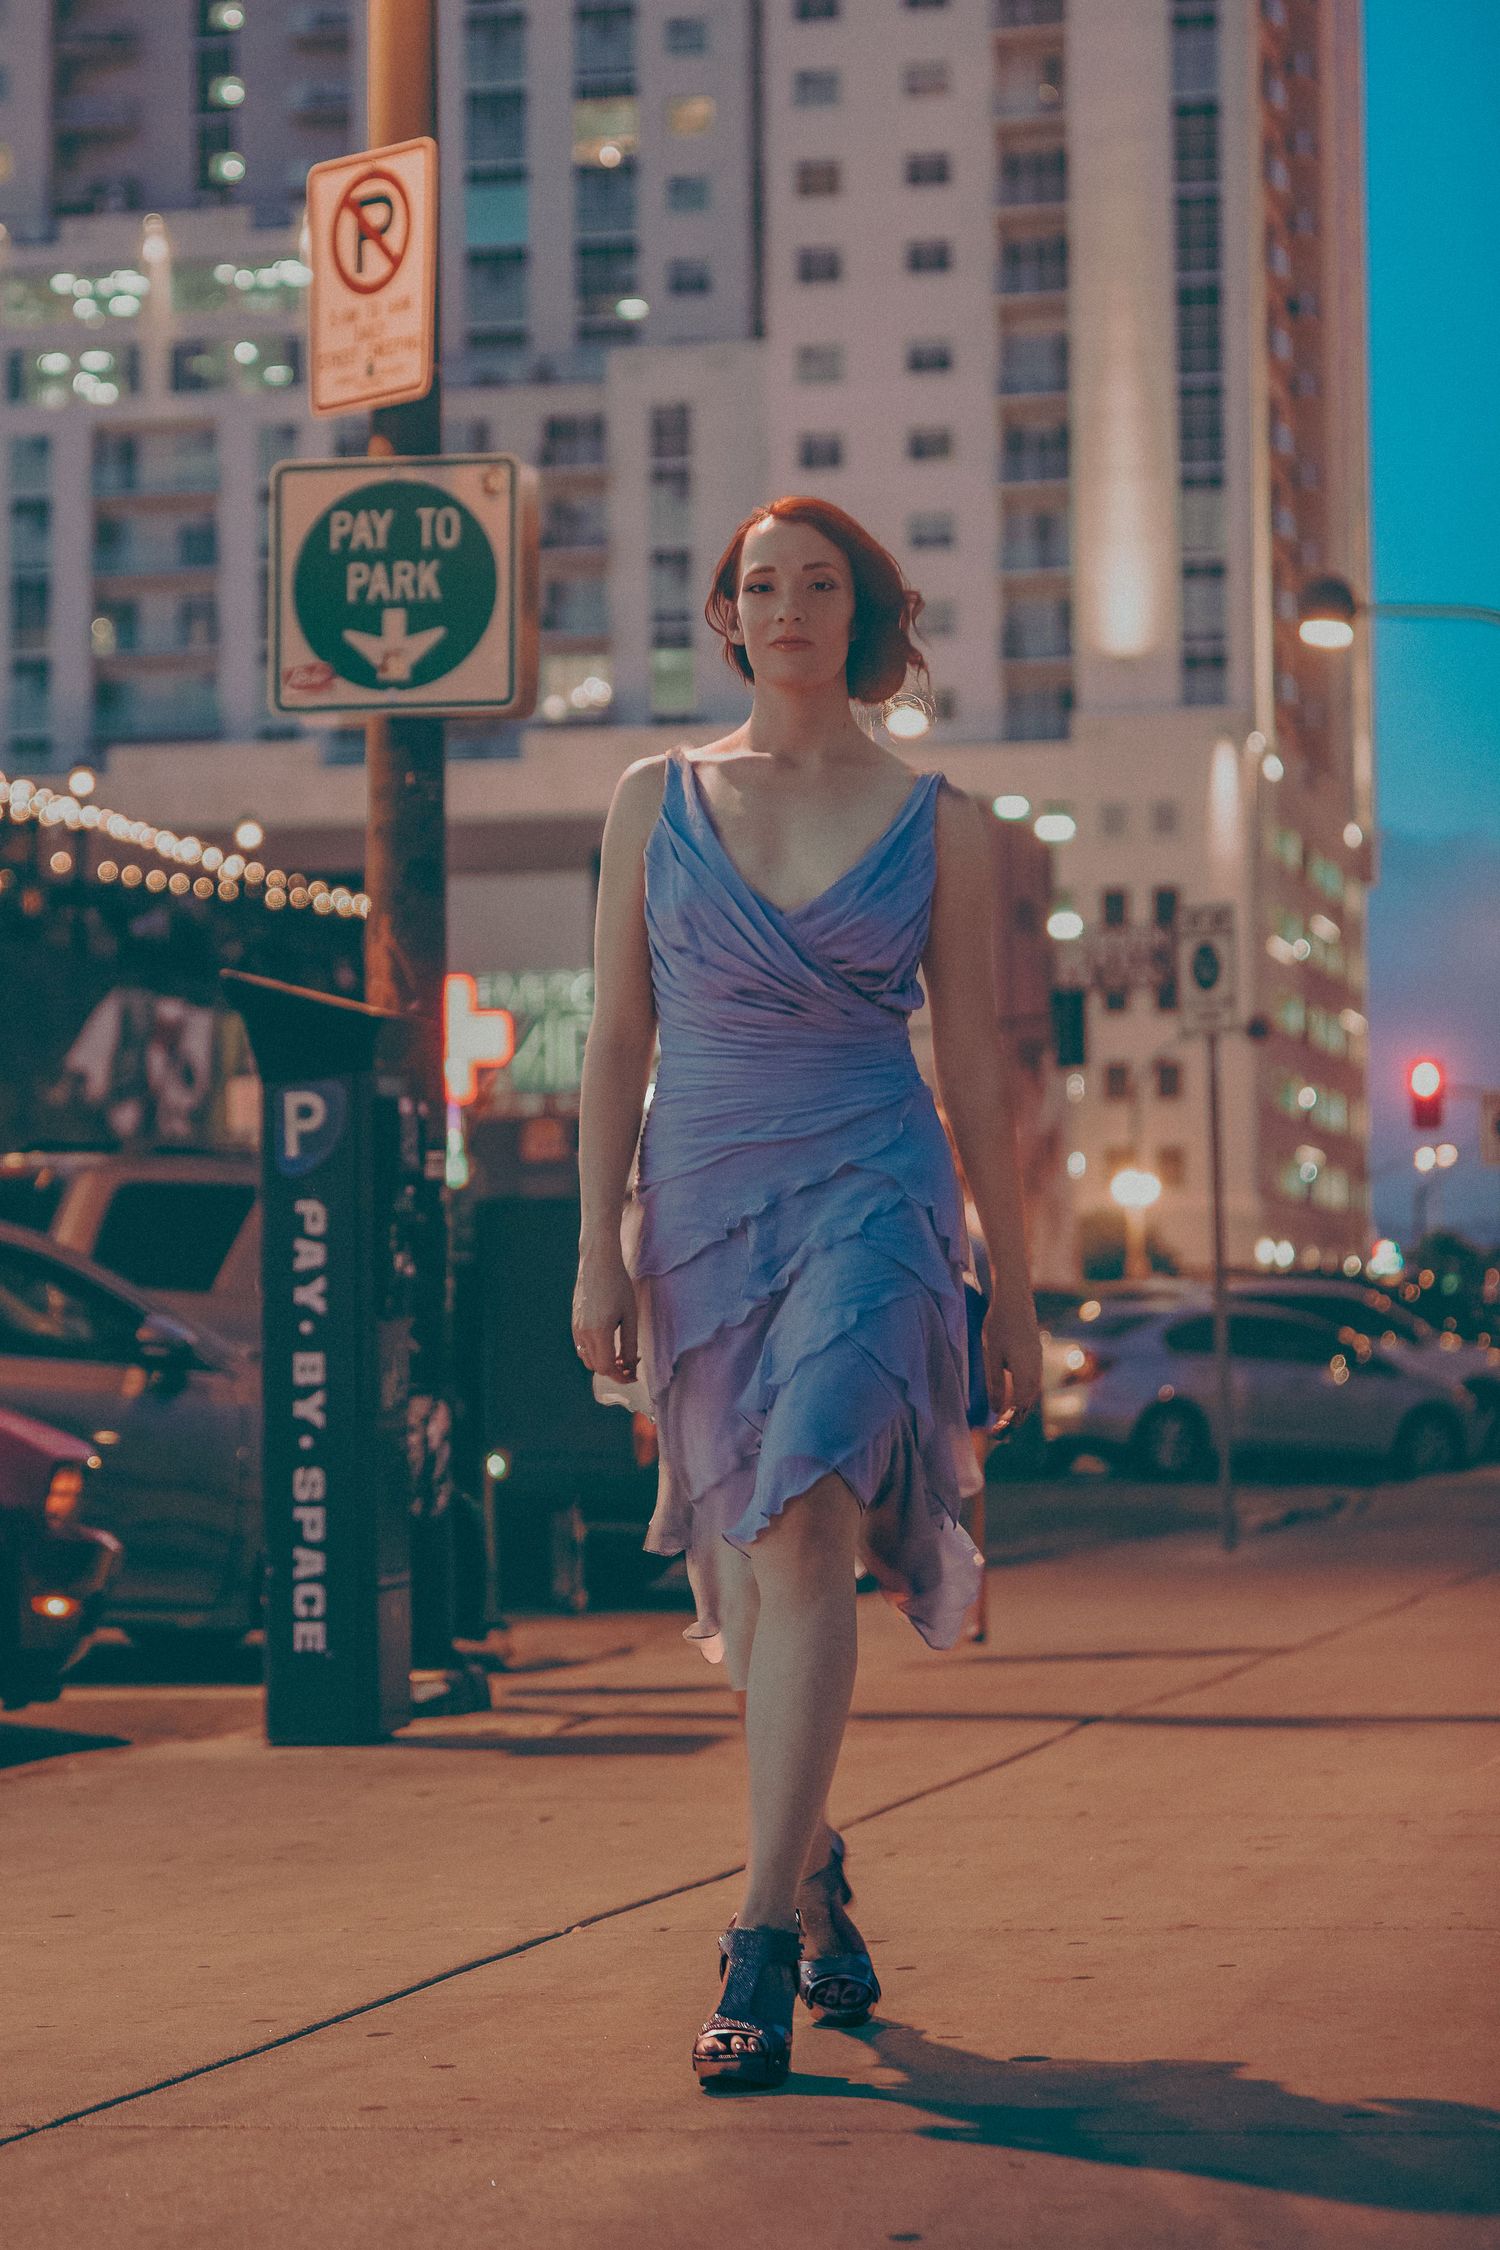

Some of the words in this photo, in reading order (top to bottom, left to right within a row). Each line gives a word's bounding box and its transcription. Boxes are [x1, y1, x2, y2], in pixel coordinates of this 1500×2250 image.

[329, 508, 394, 552] PAY
[416, 506, 461, 549] TO
[346, 559, 442, 603] PARK
[284, 1091, 327, 1158] P
